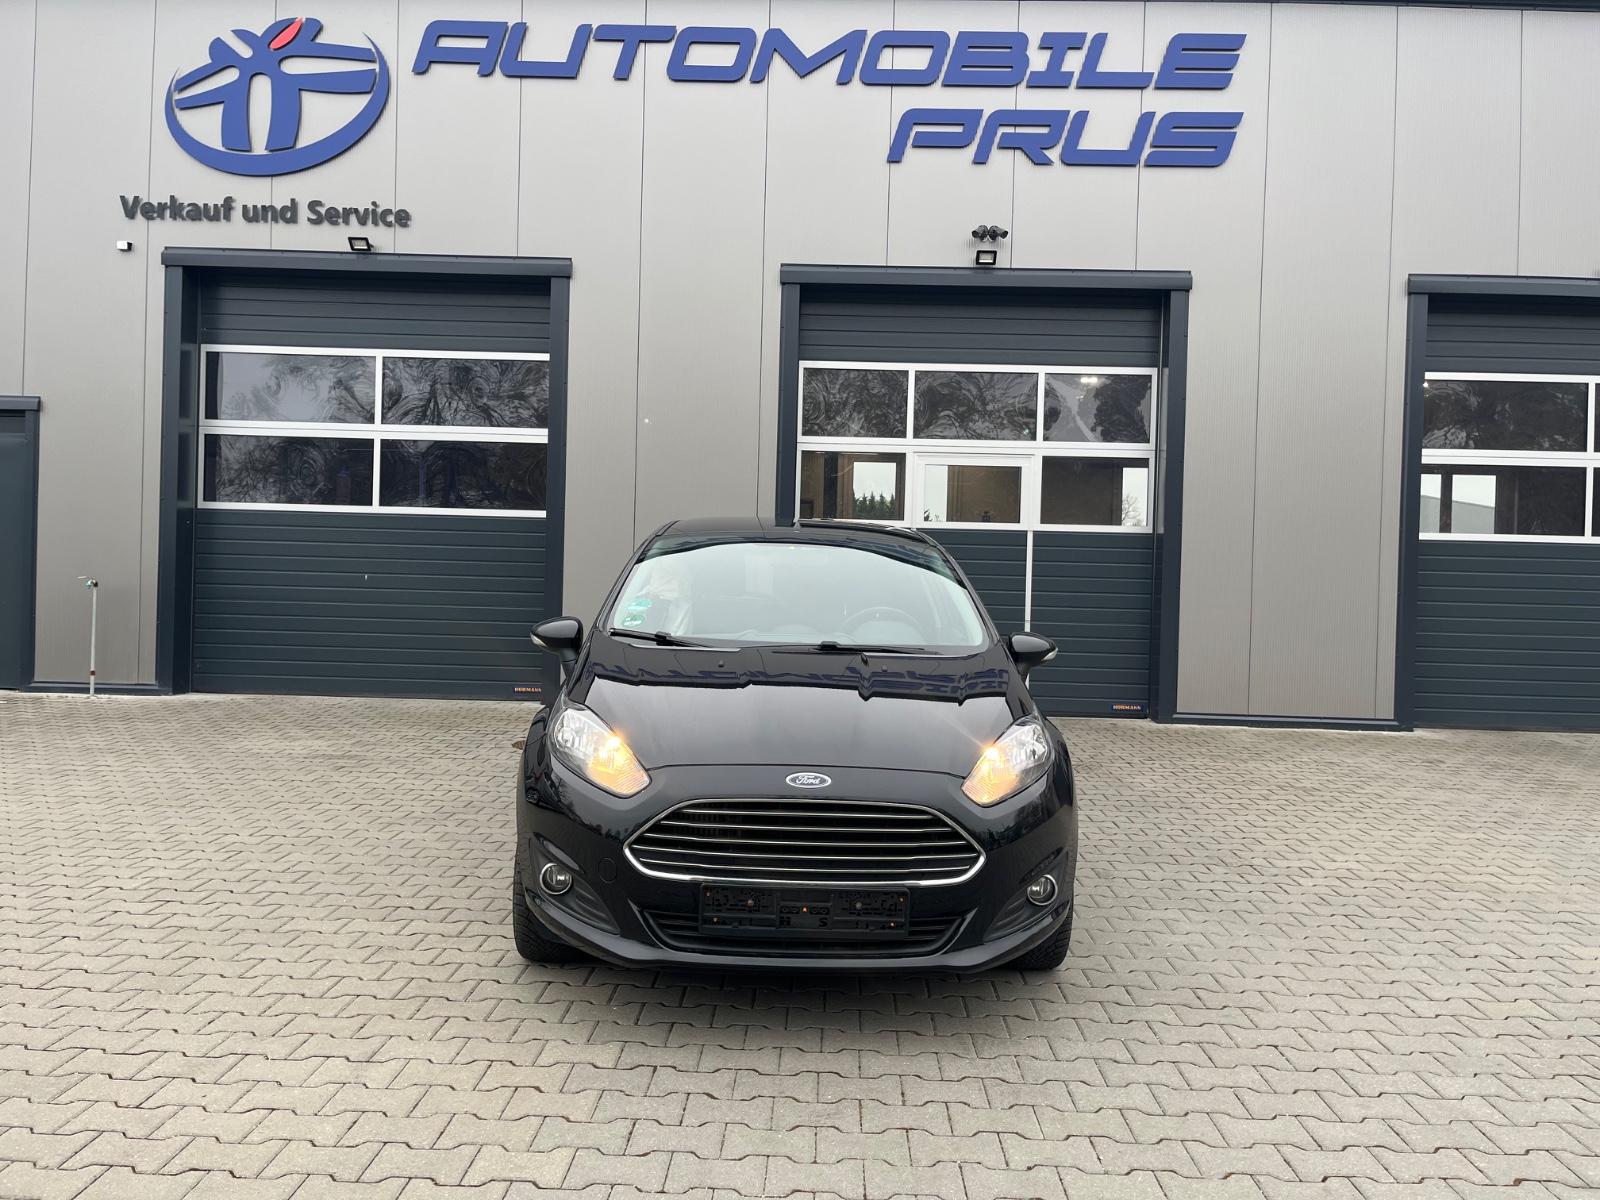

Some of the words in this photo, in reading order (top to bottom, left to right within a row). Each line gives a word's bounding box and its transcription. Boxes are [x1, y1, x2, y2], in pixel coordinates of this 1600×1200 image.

[412, 19, 1247, 91] AUTOMOBILE
[886, 107, 1245, 168] PRUS
[119, 194, 235, 222] Verkauf
[241, 198, 299, 225] und
[306, 199, 412, 229] Service
[795, 775, 821, 785] Ford
